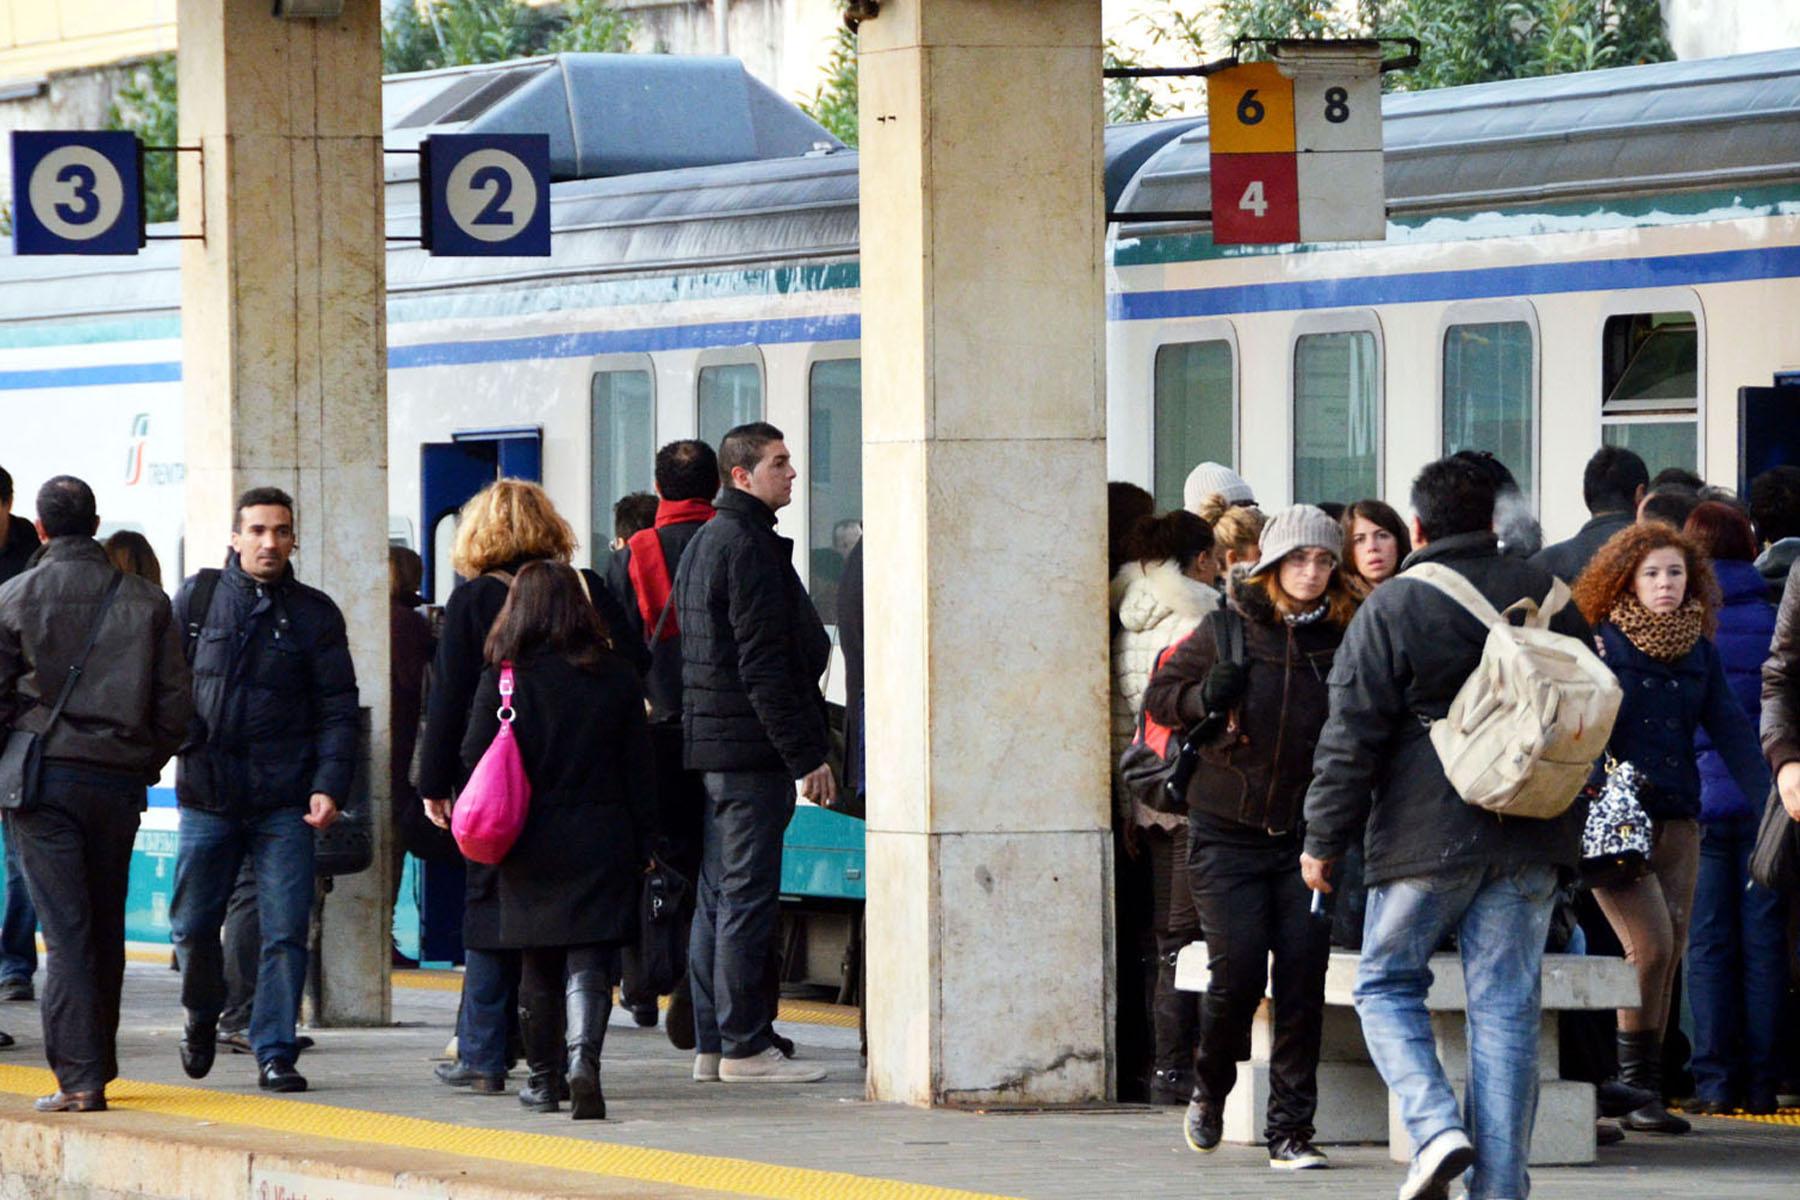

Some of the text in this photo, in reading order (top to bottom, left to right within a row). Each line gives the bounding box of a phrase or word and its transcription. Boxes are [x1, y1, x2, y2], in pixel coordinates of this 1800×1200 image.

[1237, 89, 1265, 126] 6
[1324, 86, 1350, 124] 8
[54, 164, 101, 226] 3
[469, 166, 515, 226] 2
[1239, 181, 1268, 217] 4
